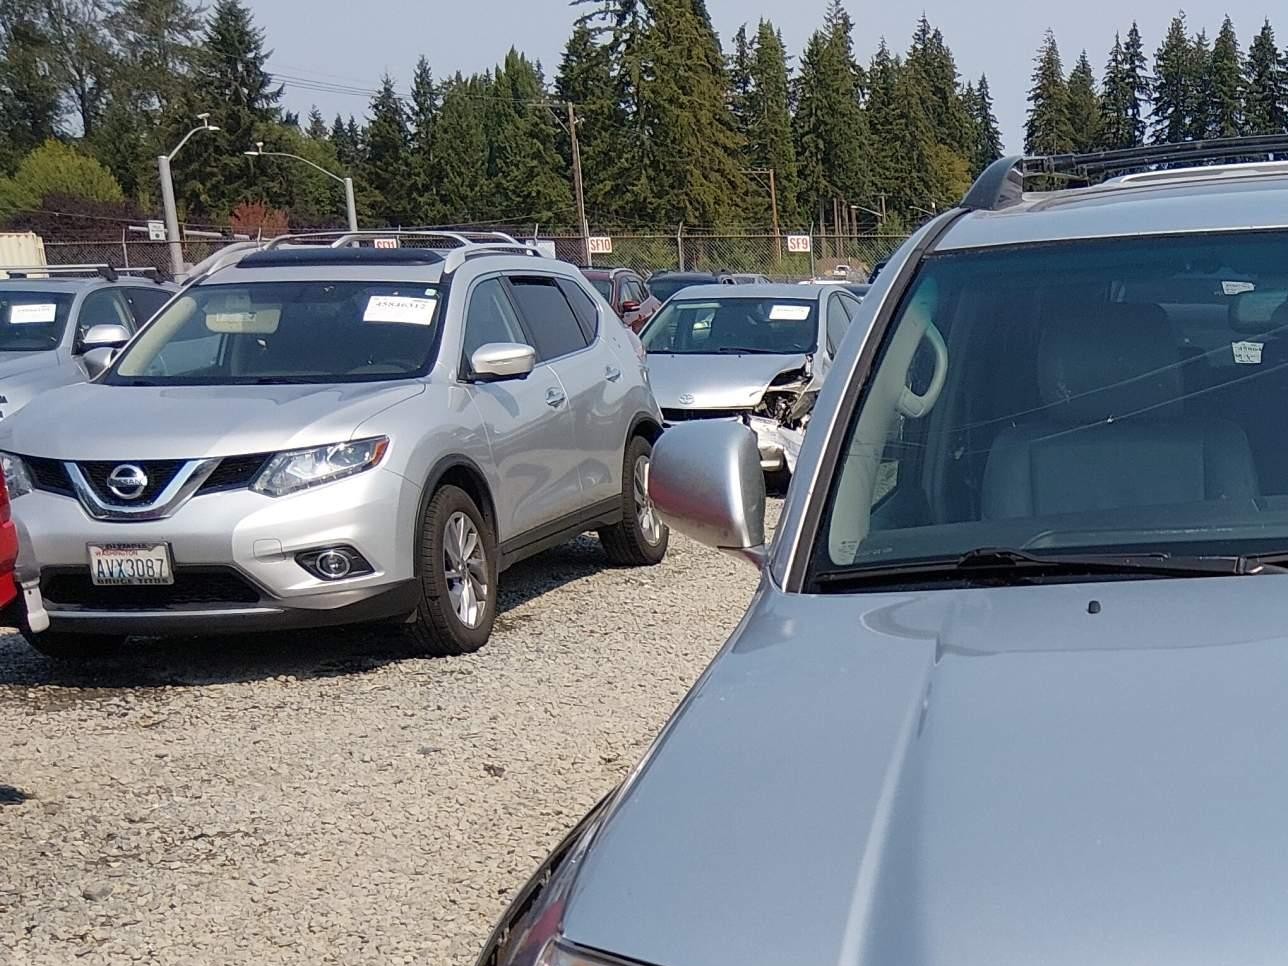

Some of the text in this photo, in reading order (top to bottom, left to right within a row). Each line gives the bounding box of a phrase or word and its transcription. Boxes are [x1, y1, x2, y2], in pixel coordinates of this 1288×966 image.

[590, 239, 611, 251] SF10
[789, 237, 809, 250] SF9
[97, 558, 164, 578] AVX3087
